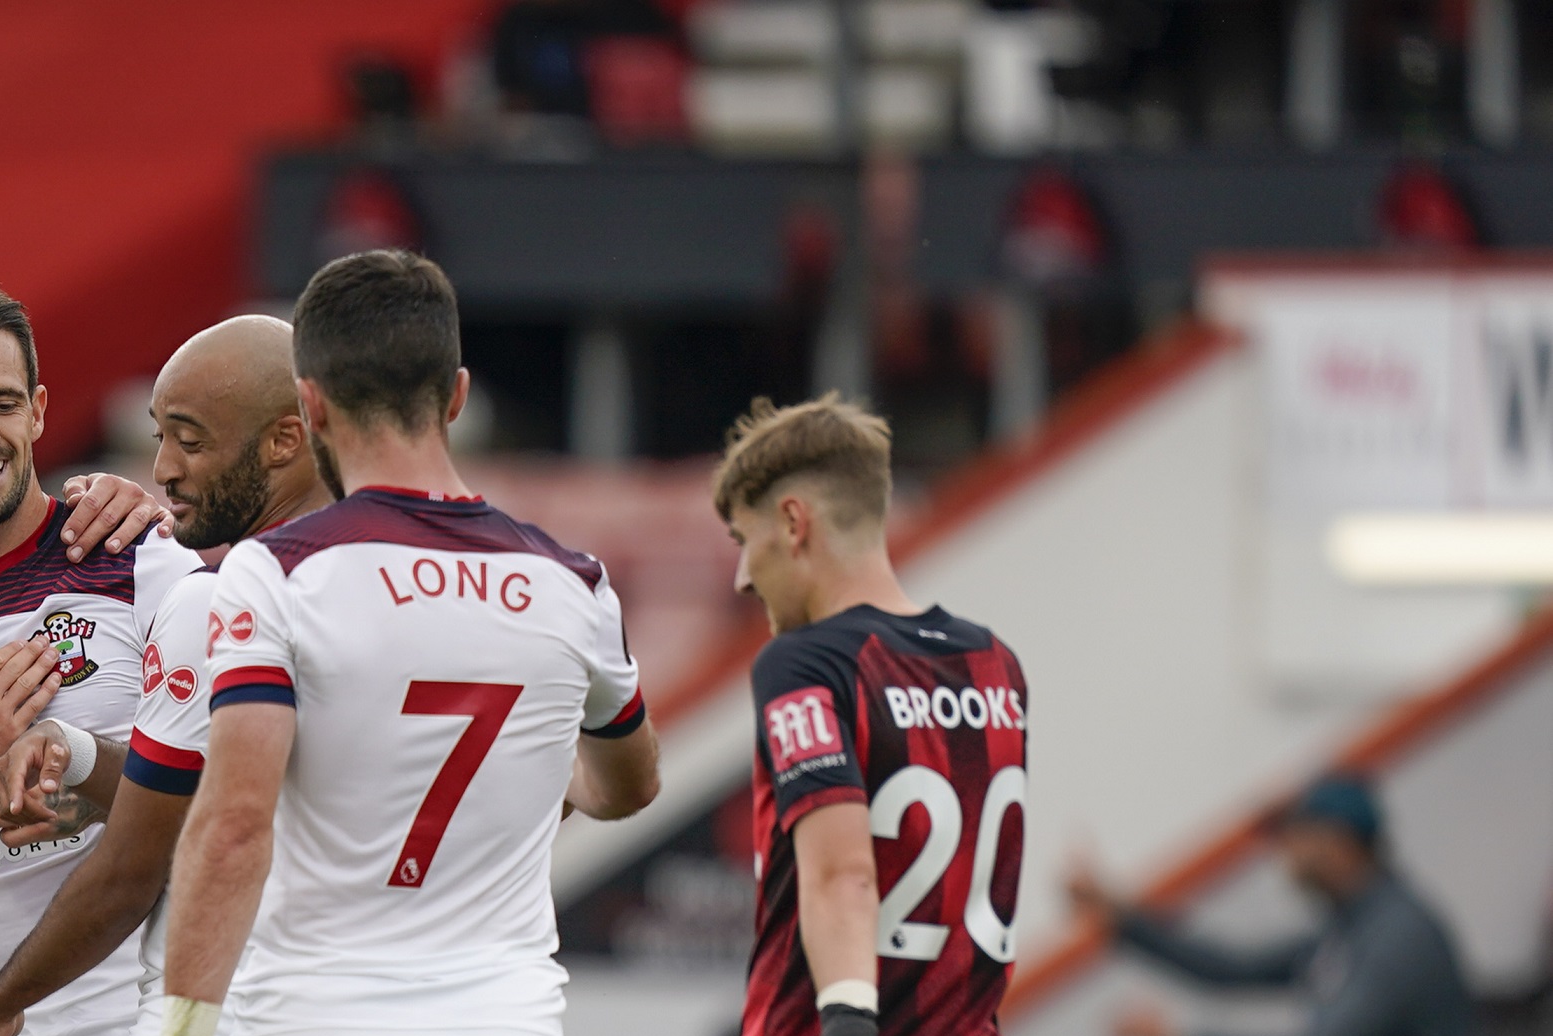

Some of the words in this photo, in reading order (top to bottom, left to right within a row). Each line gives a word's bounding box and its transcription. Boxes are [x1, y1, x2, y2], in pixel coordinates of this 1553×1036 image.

[378, 558, 533, 613] LONG
[168, 677, 193, 691] media
[884, 686, 1025, 730] BROOKS
[387, 680, 525, 889] 7
[869, 765, 1027, 963] 20
